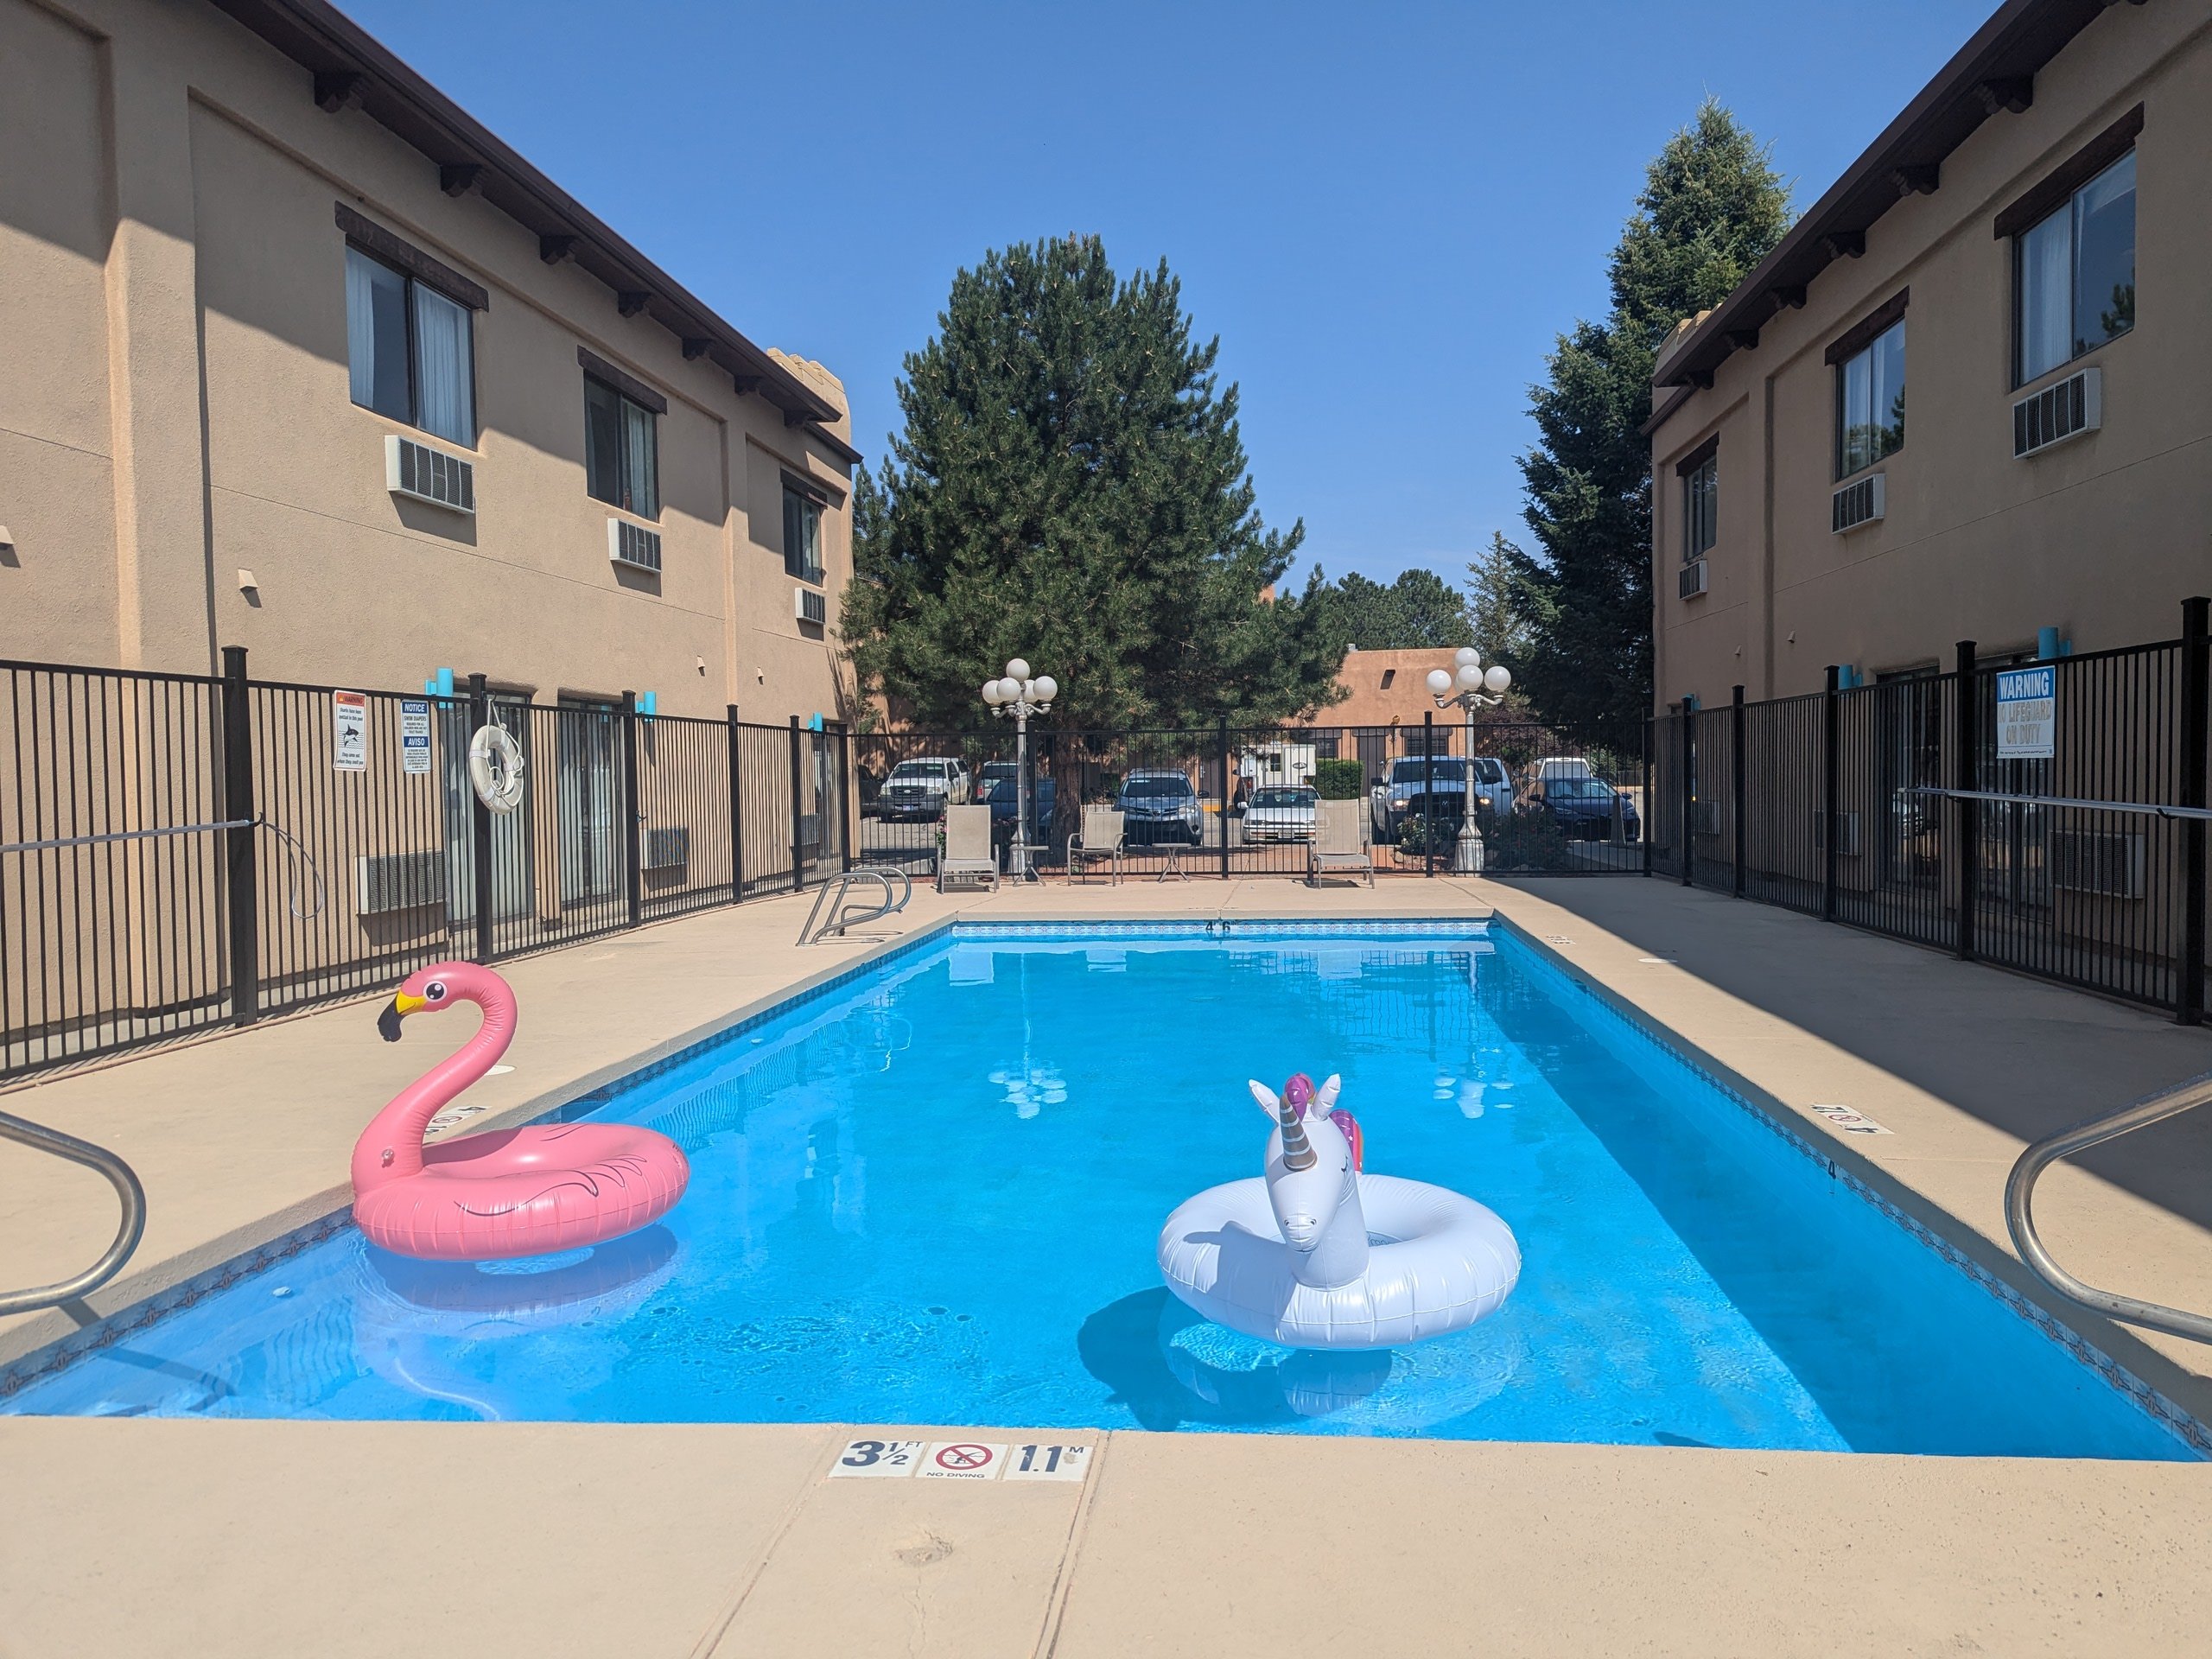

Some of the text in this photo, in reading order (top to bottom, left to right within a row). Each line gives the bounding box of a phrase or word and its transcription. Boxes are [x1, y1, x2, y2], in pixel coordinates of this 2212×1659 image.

[1999, 671, 2050, 700] WARNING
[404, 703, 425, 713] NOTICE
[2009, 700, 2052, 722] LIFEGUARD
[408, 737, 425, 747] AVISO
[2020, 724, 2040, 745] DUTY
[1205, 920, 1214, 931] 4
[1222, 920, 1231, 931] 6
[842, 1440, 886, 1466] 3
[1019, 1445, 1085, 1472] 1.1 M
